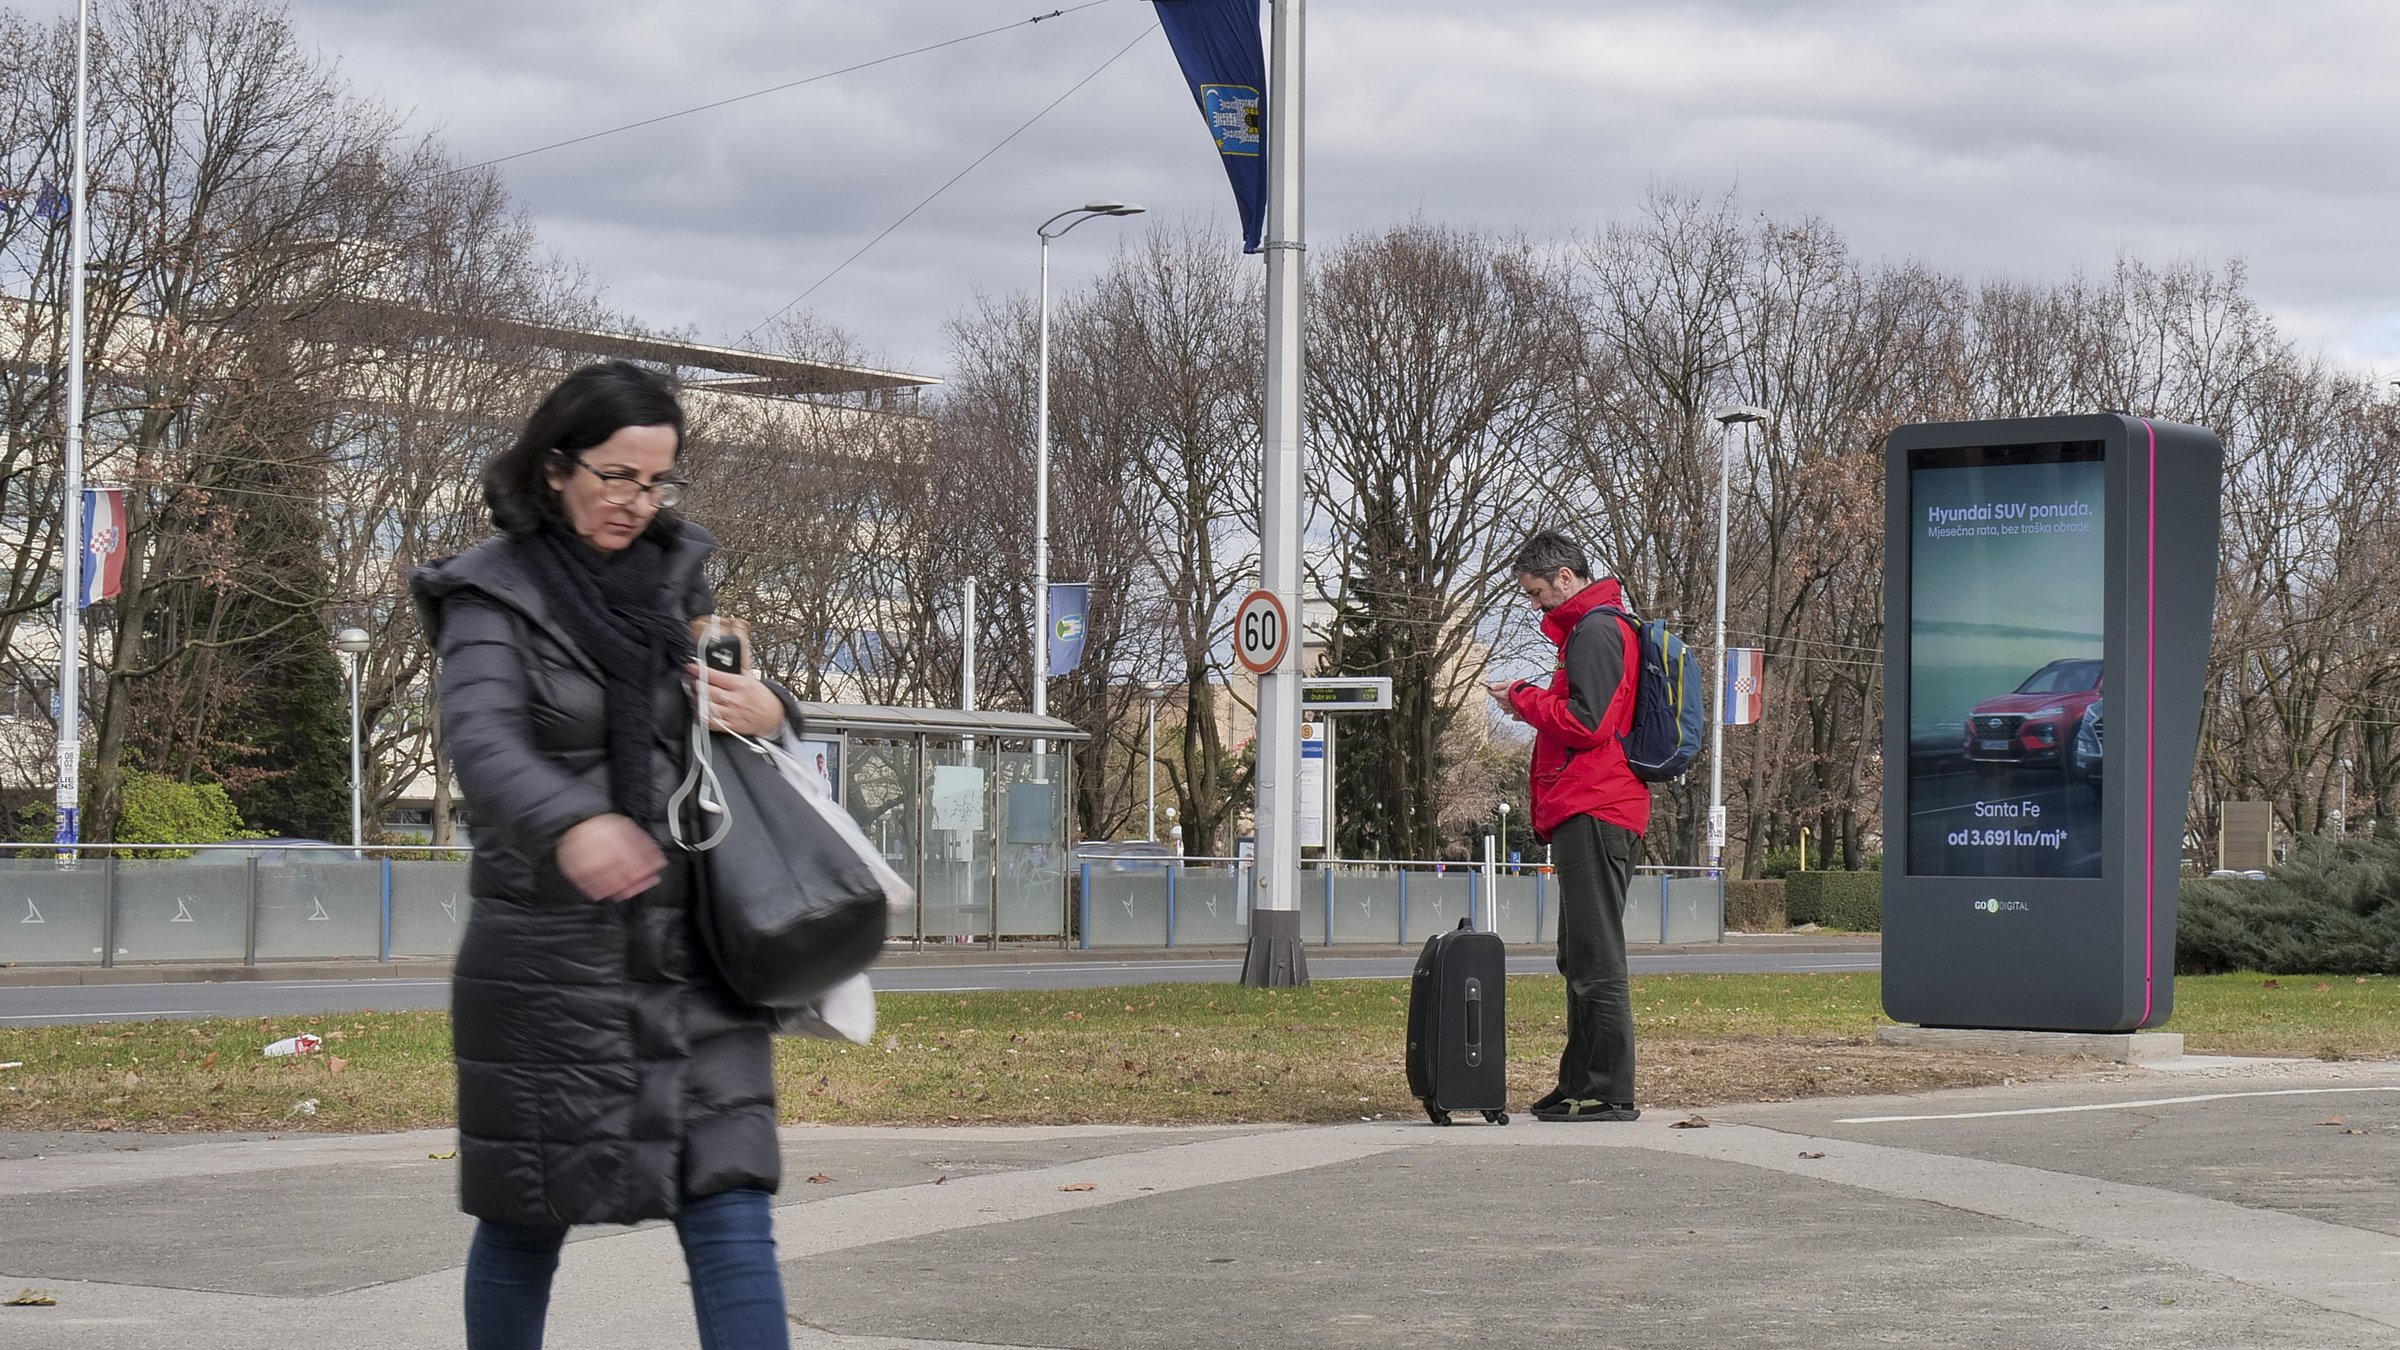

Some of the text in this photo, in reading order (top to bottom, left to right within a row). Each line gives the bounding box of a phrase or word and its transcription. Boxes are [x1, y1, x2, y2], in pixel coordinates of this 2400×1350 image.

[1928, 500, 2093, 525] Hyundai SUV ponuda.
[1928, 520, 2092, 539] Mjesečna rata, bez troška obrade.
[1245, 610, 1276, 652] 60
[1974, 801, 2040, 817] Santa Fe
[1948, 829, 1968, 846] od
[1971, 829, 2011, 846] 3.691
[1974, 900, 2030, 911] GO DIGITAL
